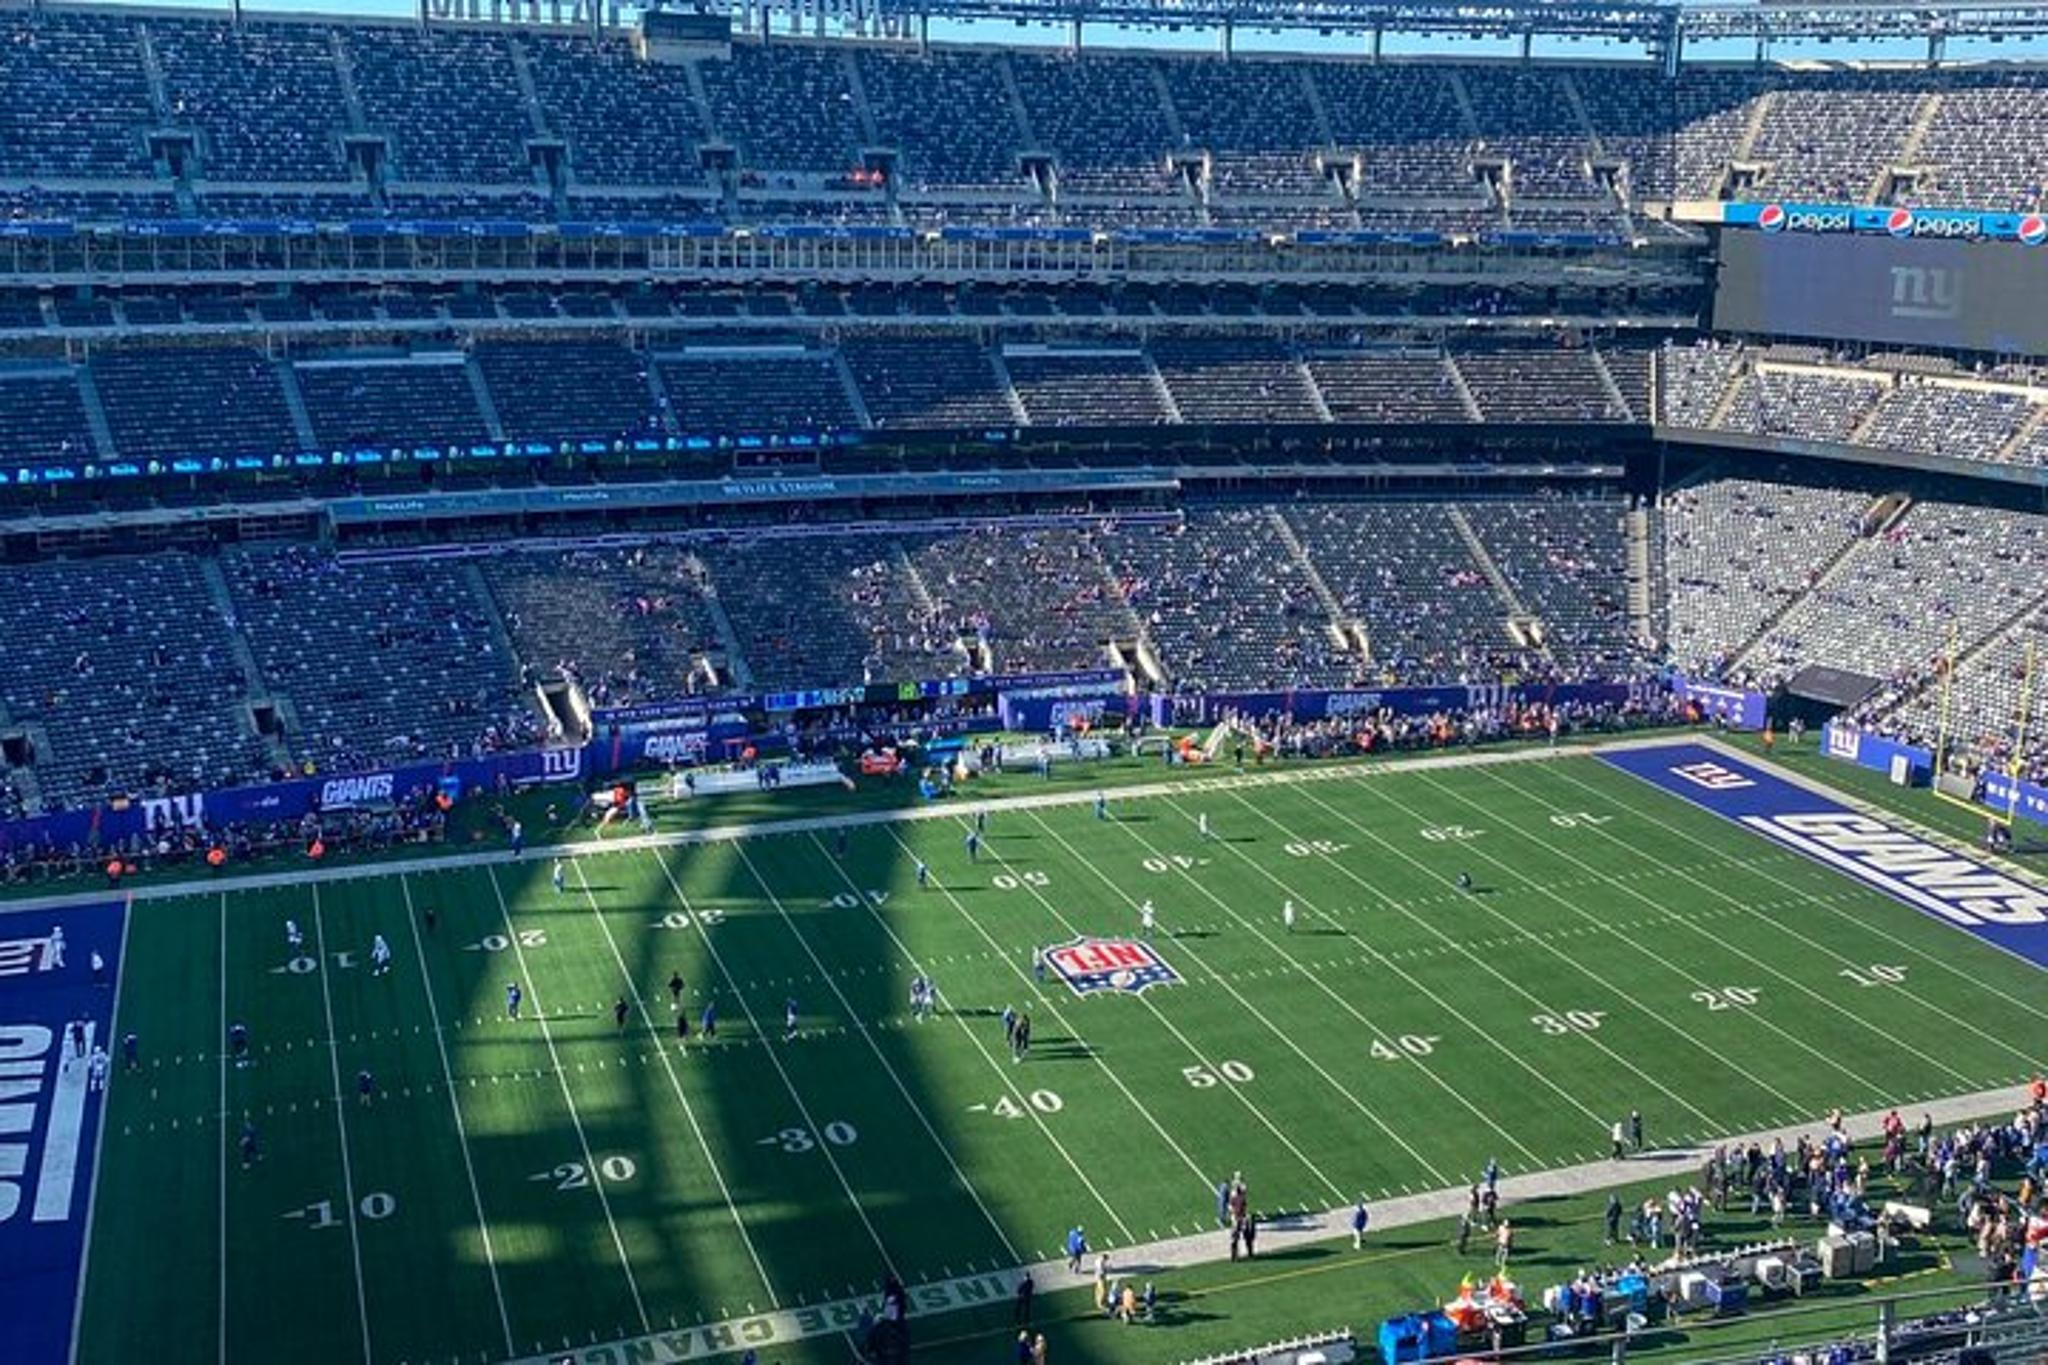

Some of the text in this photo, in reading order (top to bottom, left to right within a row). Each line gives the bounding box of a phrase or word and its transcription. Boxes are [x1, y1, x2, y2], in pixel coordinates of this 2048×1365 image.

[1787, 210, 1850, 233] pepsi
[1914, 215, 1980, 237] pepsi
[321, 773, 394, 812] GIANTS
[1774, 812, 2048, 925] GIANTS
[1057, 941, 1147, 972] NFL
[1838, 963, 1904, 988] 10
[1691, 984, 1758, 1011] 20
[1531, 1009, 1602, 1036] 30
[1369, 1033, 1434, 1062] 40
[1182, 1060, 1254, 1088] 50
[993, 1089, 1064, 1119] 40
[772, 1120, 858, 1154] 30
[552, 1155, 637, 1191] 20
[305, 1192, 396, 1231] 10
[796, 1276, 1010, 1332] INSRE
